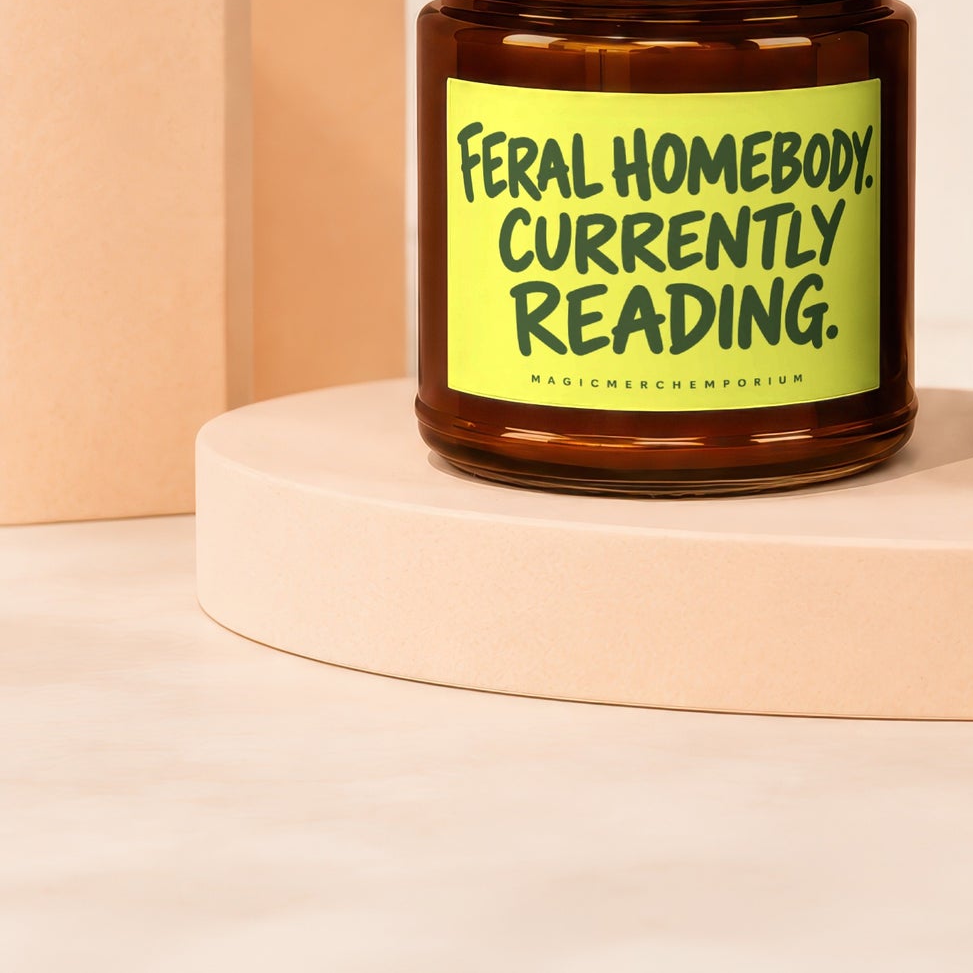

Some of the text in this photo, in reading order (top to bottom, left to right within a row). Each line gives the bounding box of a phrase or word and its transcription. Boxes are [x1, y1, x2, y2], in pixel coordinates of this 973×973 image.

[456, 121, 874, 203] FERAL HOMEBODY.
[498, 197, 847, 276] CURRENTLY
[509, 272, 839, 357] READING.
[530, 373, 805, 390] MAGICMERCHEMPORIUM
